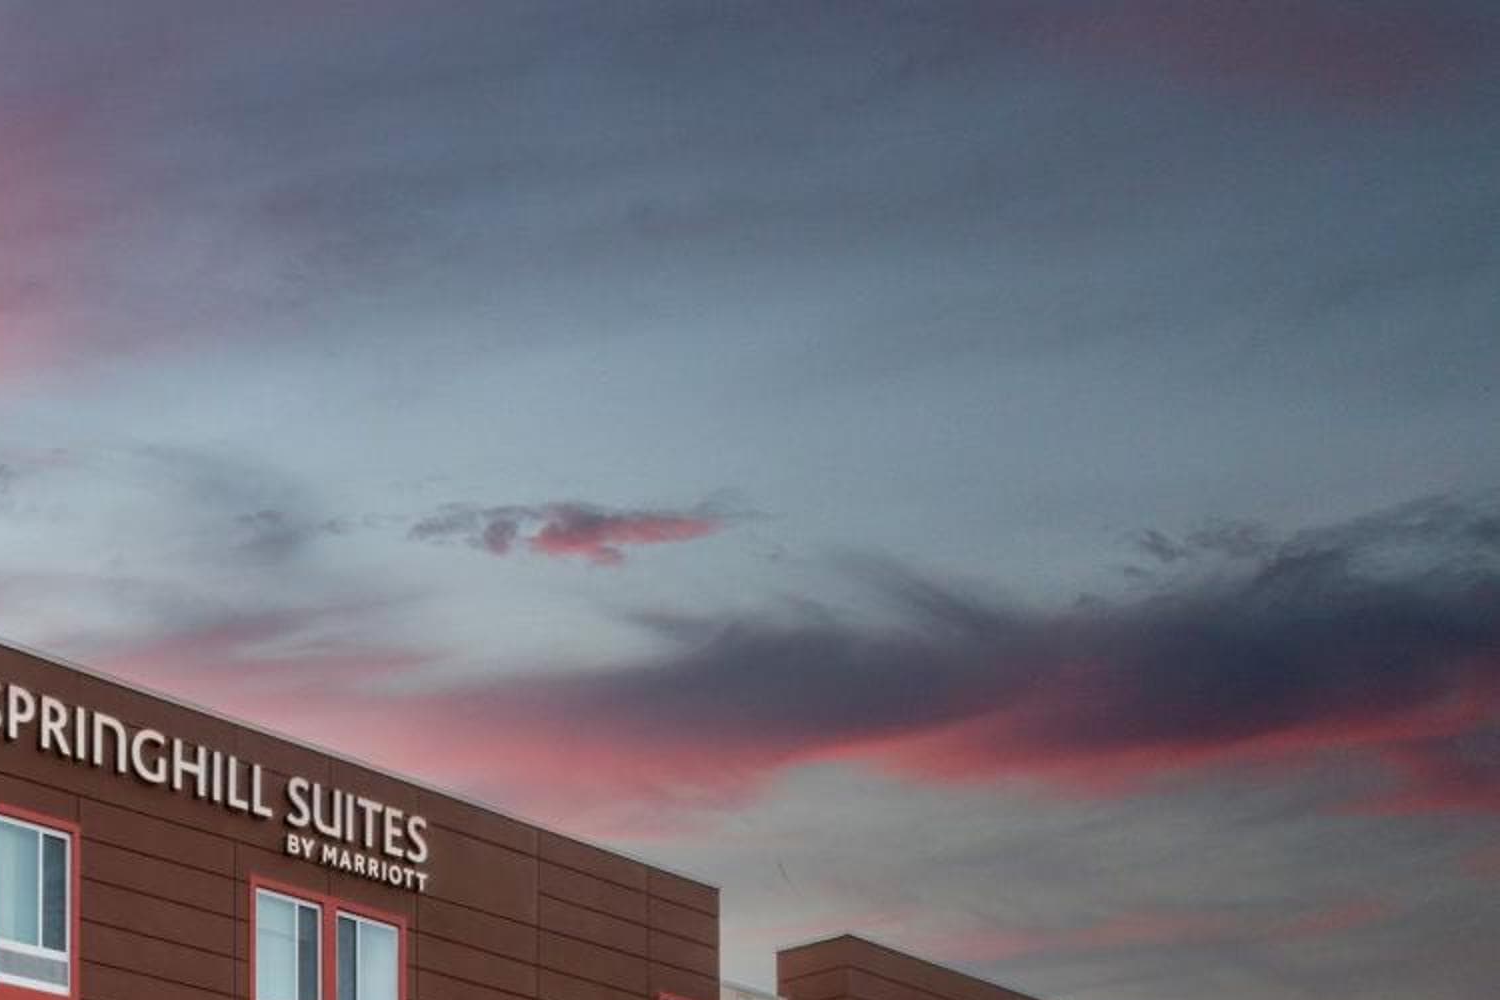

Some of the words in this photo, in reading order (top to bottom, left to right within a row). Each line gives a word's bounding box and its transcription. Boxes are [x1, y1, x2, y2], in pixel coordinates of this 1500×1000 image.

[287, 776, 428, 863] SUITES
[287, 833, 315, 859] BY
[323, 843, 429, 892] MARRIOTT
